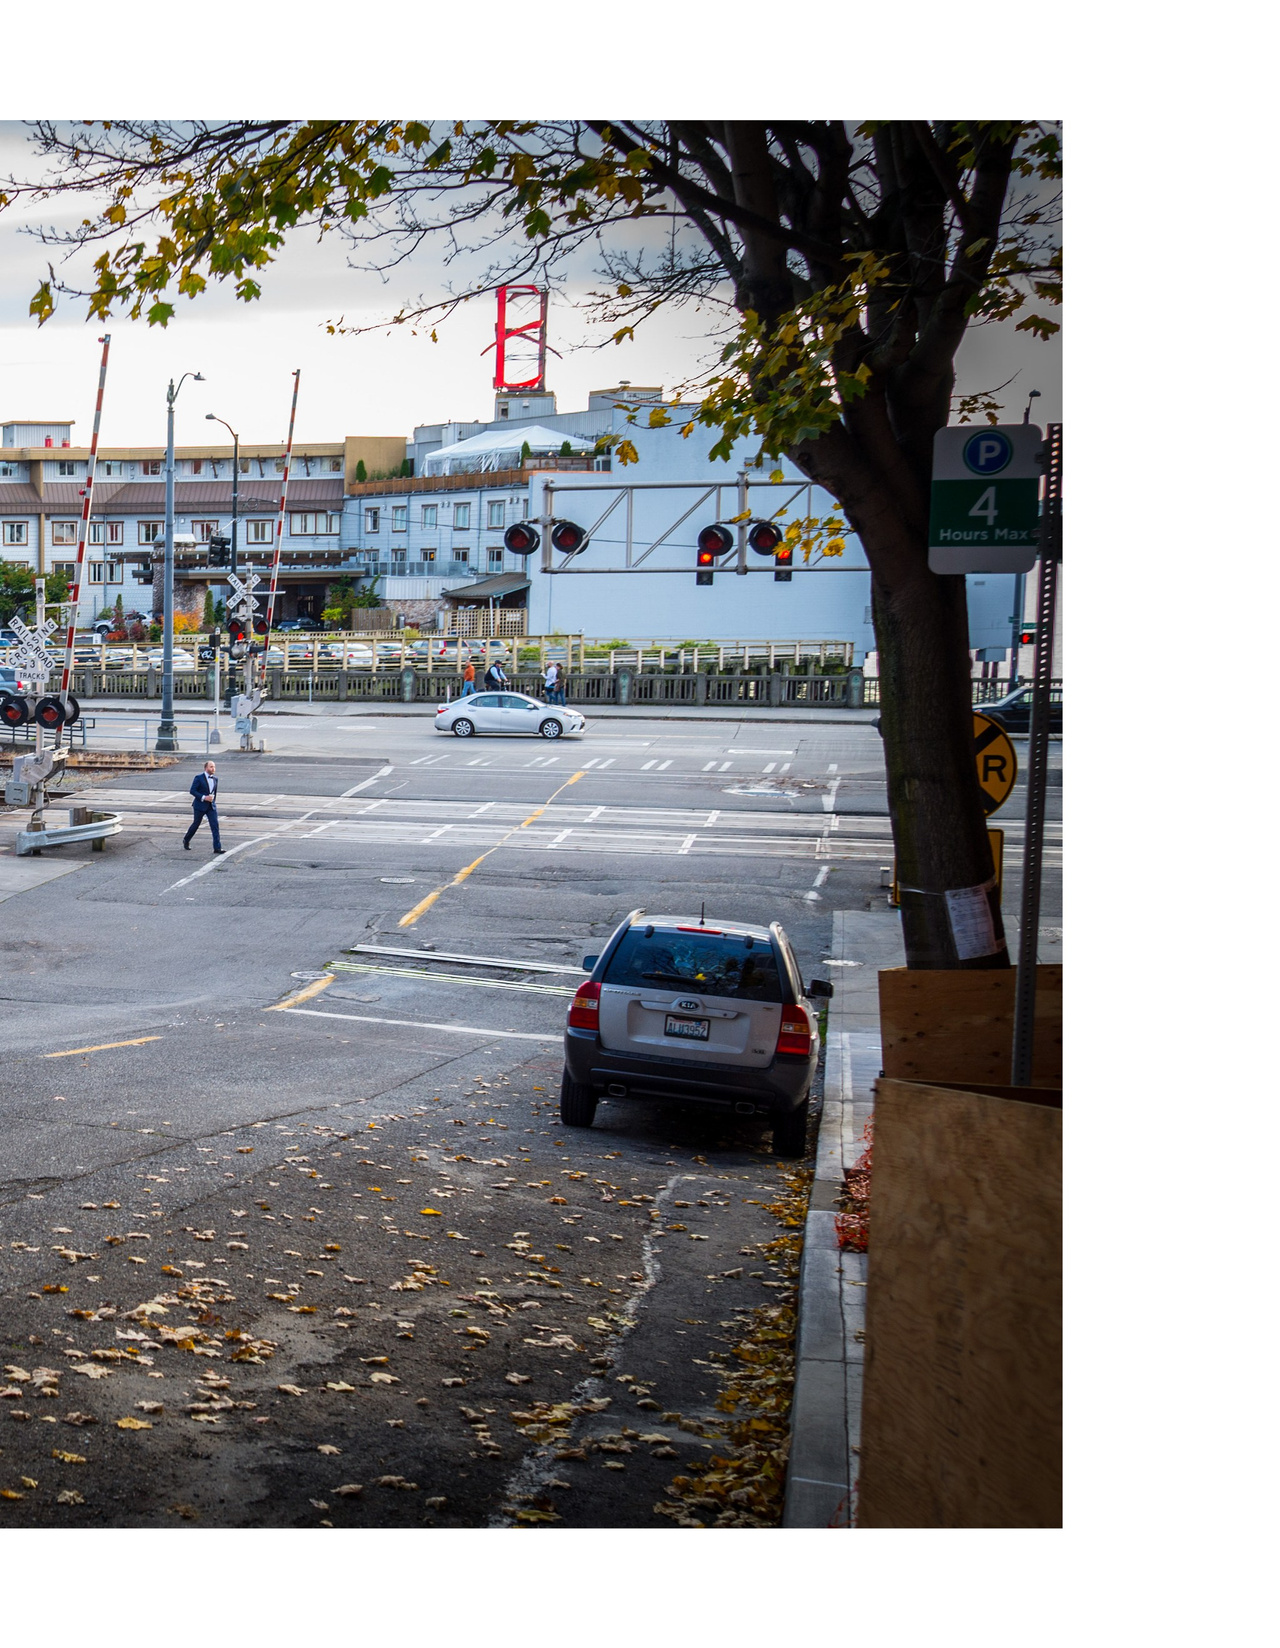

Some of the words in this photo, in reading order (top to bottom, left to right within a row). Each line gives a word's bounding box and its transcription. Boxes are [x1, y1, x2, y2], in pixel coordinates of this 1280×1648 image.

[978, 440, 1002, 466] P
[968, 486, 999, 526] 4
[939, 529, 988, 541] Hours
[994, 528, 1028, 540] Max
[9, 621, 55, 666] CROSSING
[30, 660, 35, 668] 3
[20, 672, 45, 680] TRACKS
[982, 755, 1007, 782] R
[681, 1001, 696, 1009] KIA
